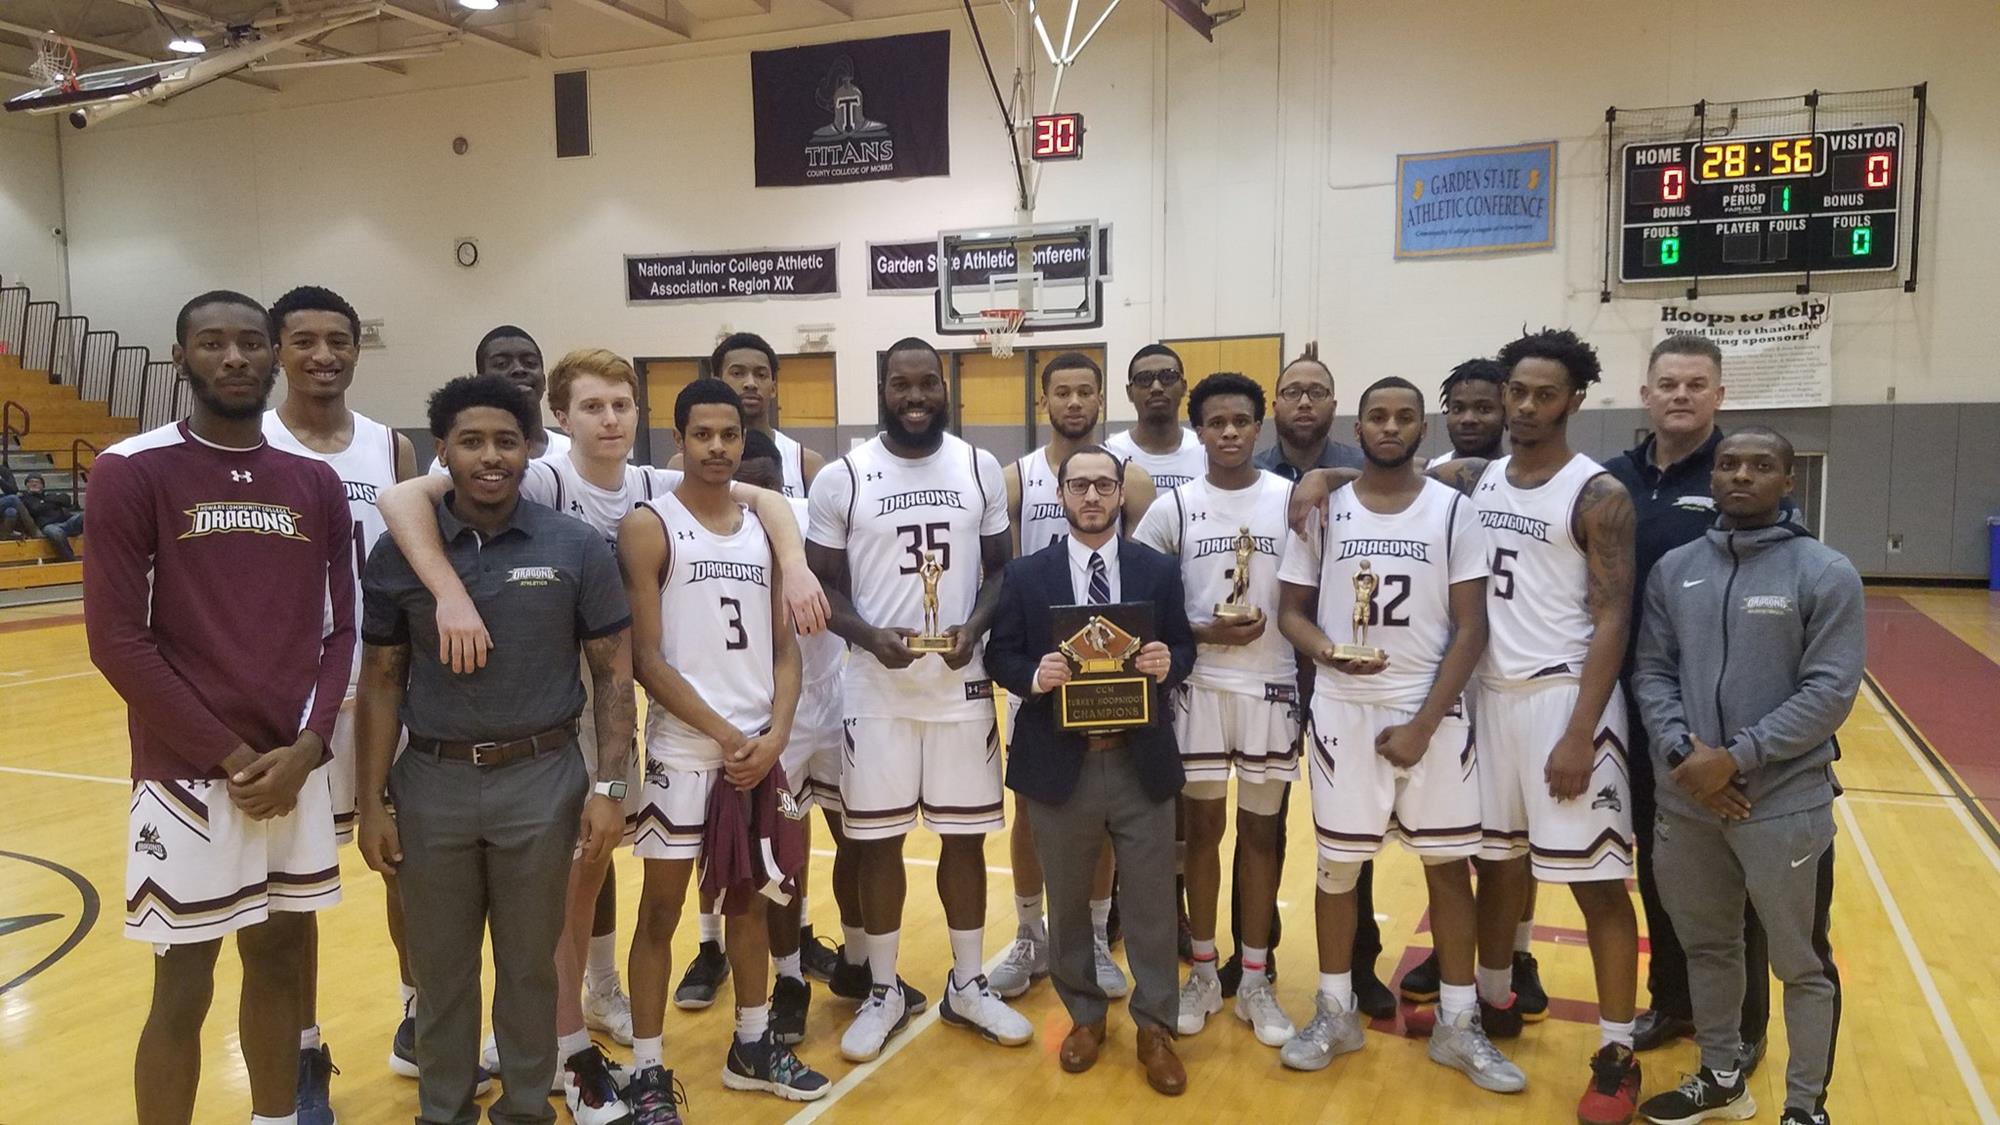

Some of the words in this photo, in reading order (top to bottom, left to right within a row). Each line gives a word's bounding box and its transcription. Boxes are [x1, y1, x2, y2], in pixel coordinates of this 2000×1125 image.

[1037, 118, 1074, 154] 30
[1830, 131, 1897, 151] VISITOR
[805, 140, 894, 167] TITANS
[1635, 147, 1682, 165] HOME
[1702, 138, 1812, 179] 28:56
[806, 169, 831, 178] COUNTY
[831, 167, 860, 177] COLLEGE
[861, 166, 869, 174] OF
[870, 163, 893, 173] MORRIS
[1431, 169, 1481, 196] GARDEN
[1483, 168, 1521, 190] STATE
[1867, 155, 1890, 188] 0
[1663, 168, 1684, 200] 0
[1732, 183, 1757, 194] POSS
[1722, 193, 1766, 207] PERIOD
[1782, 186, 1791, 212] 1
[1823, 193, 1865, 207] BONUS
[1407, 197, 1463, 228] ATHLETIC
[1465, 195, 1545, 218] CONFERENCE
[1653, 205, 1692, 219] BONUS
[1833, 215, 1872, 229] FOULS
[1643, 226, 1679, 239] FOULS
[1716, 221, 1760, 235] PLAYER
[1769, 218, 1807, 232] FOULS
[1661, 238, 1680, 265] 0
[1852, 228, 1871, 256] 0
[638, 262, 686, 278] National
[688, 260, 726, 275] Junior
[729, 257, 773, 275] College
[776, 254, 824, 271] Athletic
[877, 255, 924, 274] Garden
[963, 249, 1015, 270] Athletic
[650, 279, 718, 296] Association
[729, 277, 771, 294] Region
[773, 275, 794, 291] XIX
[1661, 305, 1735, 327] Hoops
[1768, 300, 1826, 321] Help
[1665, 327, 1706, 338] Would
[1709, 327, 1734, 337] like
[1738, 328, 1752, 336] to
[1754, 324, 1796, 336] thank
[1798, 321, 1821, 332] the
[1742, 332, 1810, 347] sponsors!
[261, 505, 288, 514] COLLEGE
[878, 490, 963, 515] DRAGONS
[193, 508, 297, 536] DRAGONS
[896, 521, 951, 576] 35
[1196, 536, 1277, 558] DRANS
[1339, 539, 1429, 563] DRAGONS
[511, 567, 555, 580] DRAGONS
[690, 561, 767, 587] DRAGONS
[1492, 547, 1519, 600] 5
[720, 596, 749, 650] 3
[1096, 686, 1114, 694] CCM
[1072, 706, 1140, 720] CHAMPIONS
